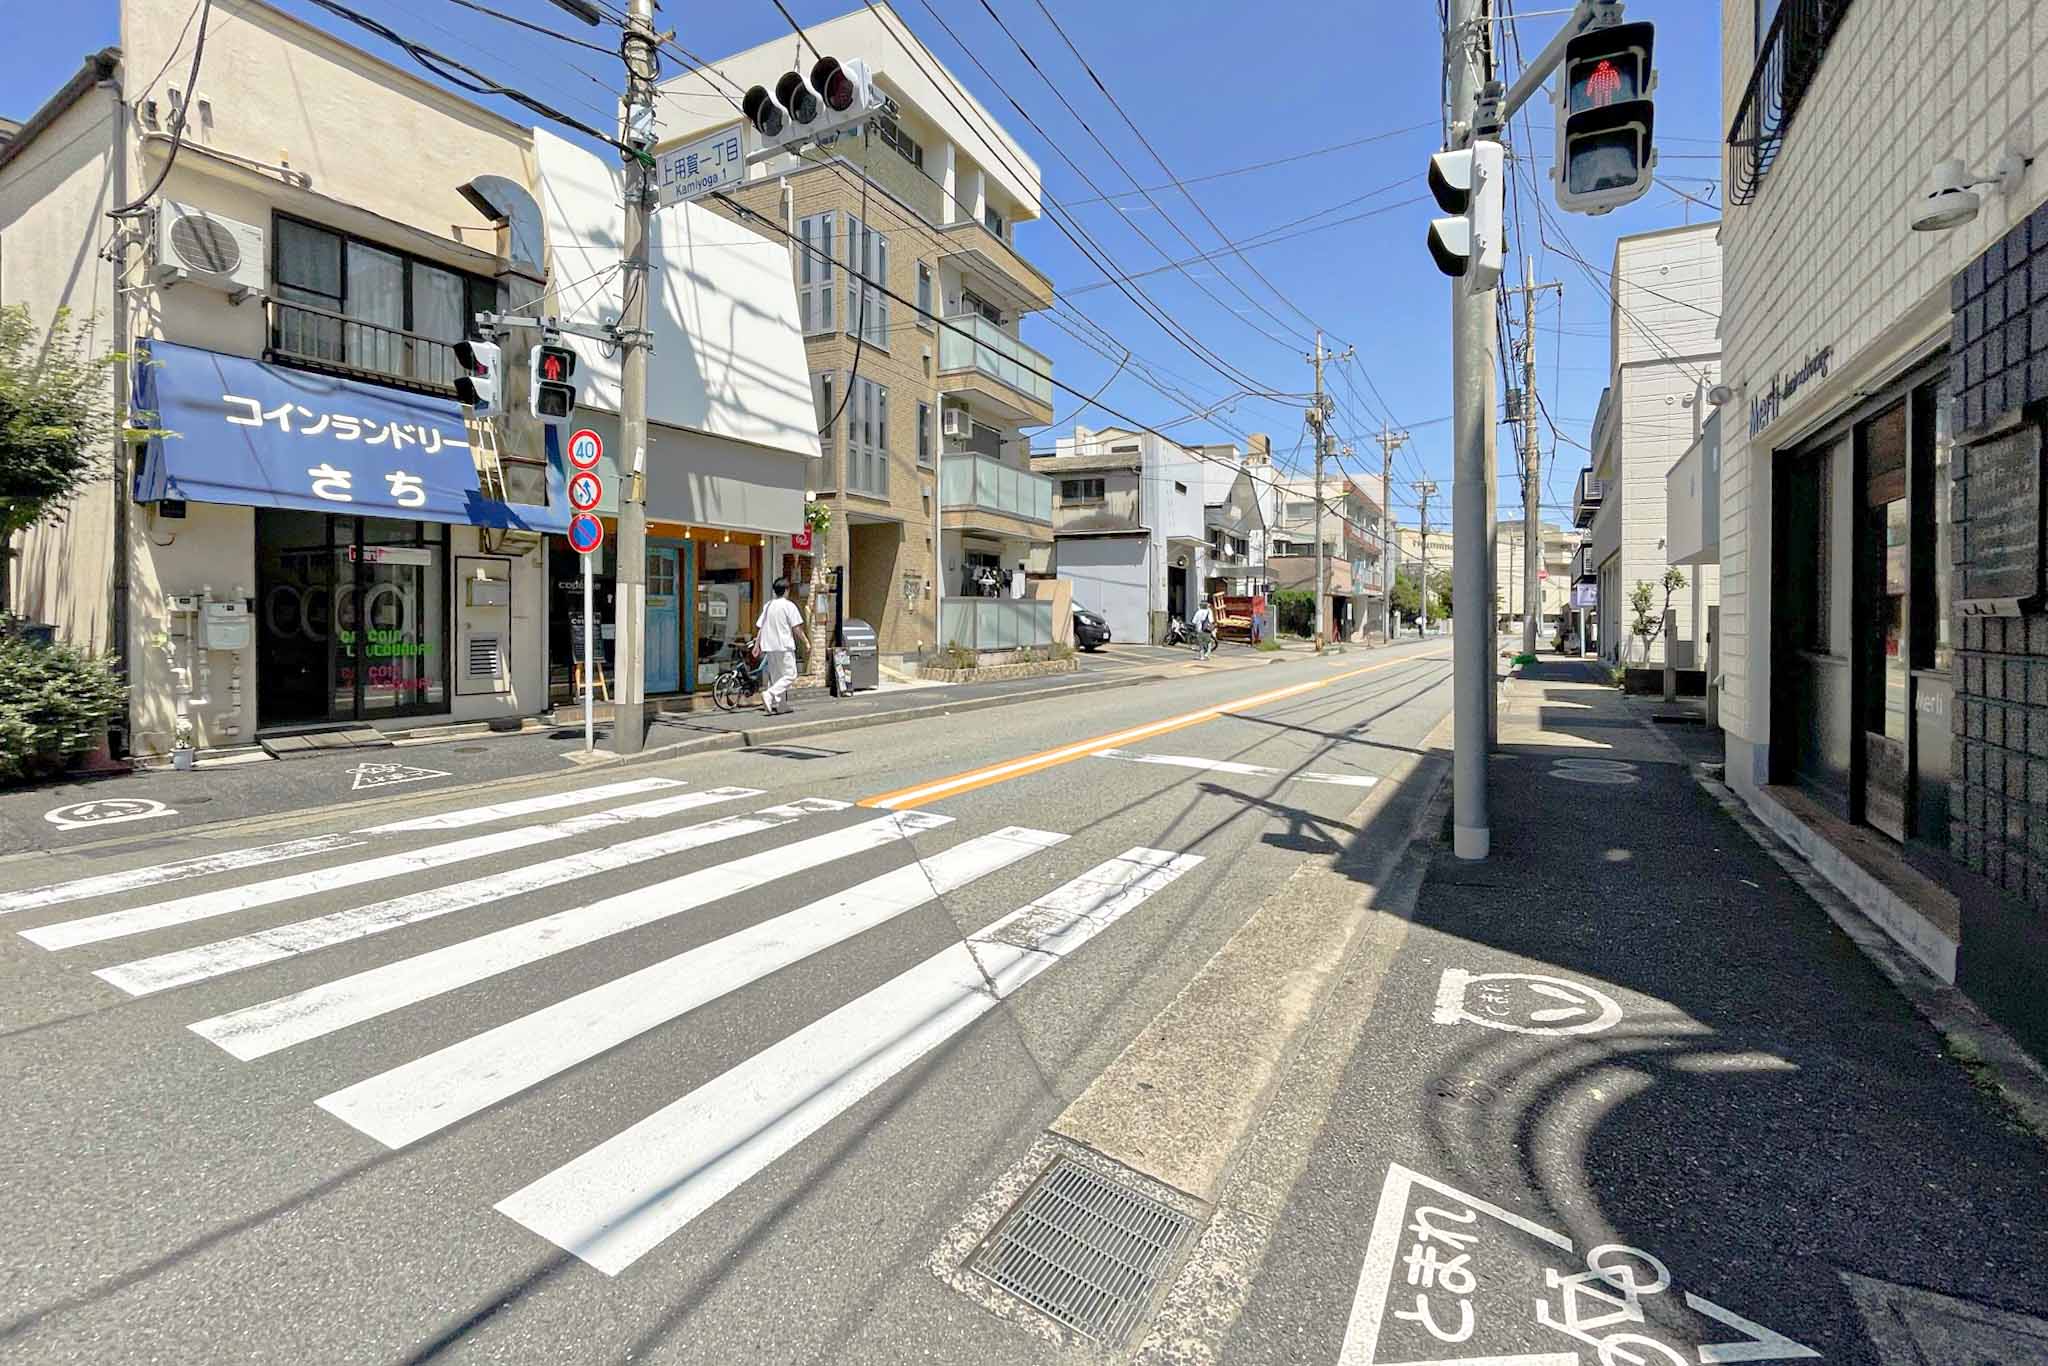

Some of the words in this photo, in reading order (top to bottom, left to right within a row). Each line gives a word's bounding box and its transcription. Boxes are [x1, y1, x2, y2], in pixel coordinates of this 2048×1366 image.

[662, 137, 739, 187] 上用賀一丁目
[675, 173, 719, 196] Kamiyoga
[722, 168, 727, 179] 1
[223, 394, 470, 453] コインランドリー
[575, 441, 594, 458] 40
[308, 463, 426, 507] さち
[1395, 1205, 1480, 1343] とまれ
